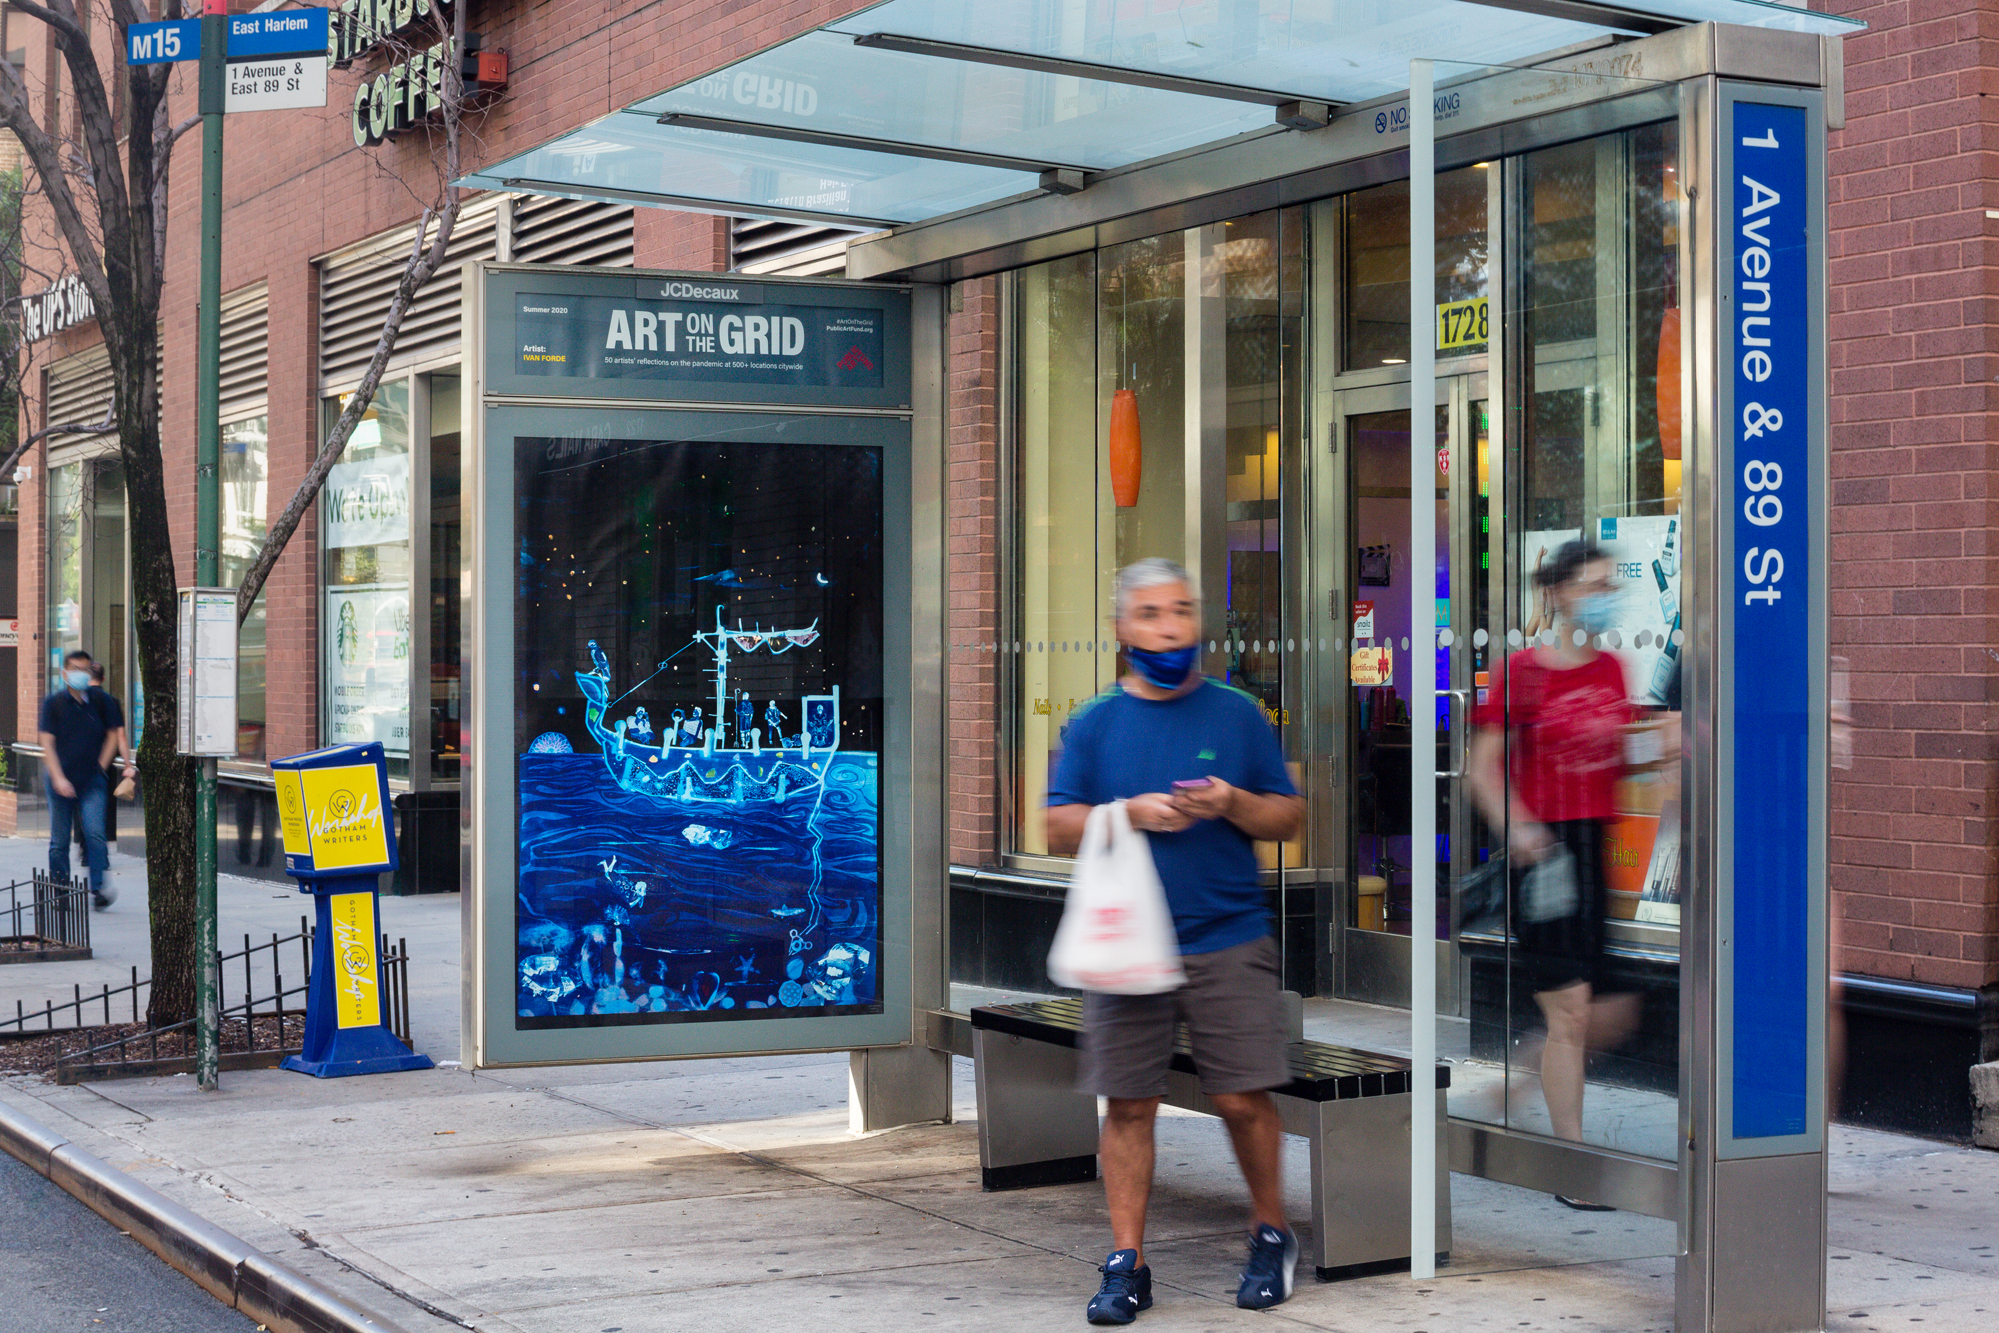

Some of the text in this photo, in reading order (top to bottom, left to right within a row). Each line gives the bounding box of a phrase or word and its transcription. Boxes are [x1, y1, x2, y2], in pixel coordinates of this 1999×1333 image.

[232, 17, 309, 35] East Harlem
[132, 27, 181, 60] M15
[232, 62, 303, 79] 1 Avenue &
[231, 77, 300, 95] East 89 St
[353, 35, 460, 147] COFFE
[1390, 107, 1407, 126] NO
[661, 282, 739, 300] JCDecaux
[22, 298, 41, 344] The
[42, 277, 66, 336] UPS
[523, 305, 550, 314] Summer
[826, 325, 874, 334] PublicArtFund.org
[1441, 302, 1489, 344] 1728
[605, 309, 805, 356] ART ON THE GRID
[523, 344, 546, 353] Artist:
[523, 354, 540, 362] IVAN
[637, 358, 669, 366] reflections
[692, 360, 723, 368] pandemic
[778, 363, 804, 371] citywide
[1741, 127, 1785, 606] 1 Avenue & 89 St
[1617, 562, 1642, 578] FREE
[1360, 651, 1370, 660] Gift
[1351, 663, 1378, 672] Certificates
[1355, 675, 1376, 684] Available
[1033, 698, 1052, 716] Nails
[323, 824, 367, 834] GOTHAM
[323, 834, 368, 844] WRITERS
[349, 899, 357, 940] GOTHAM
